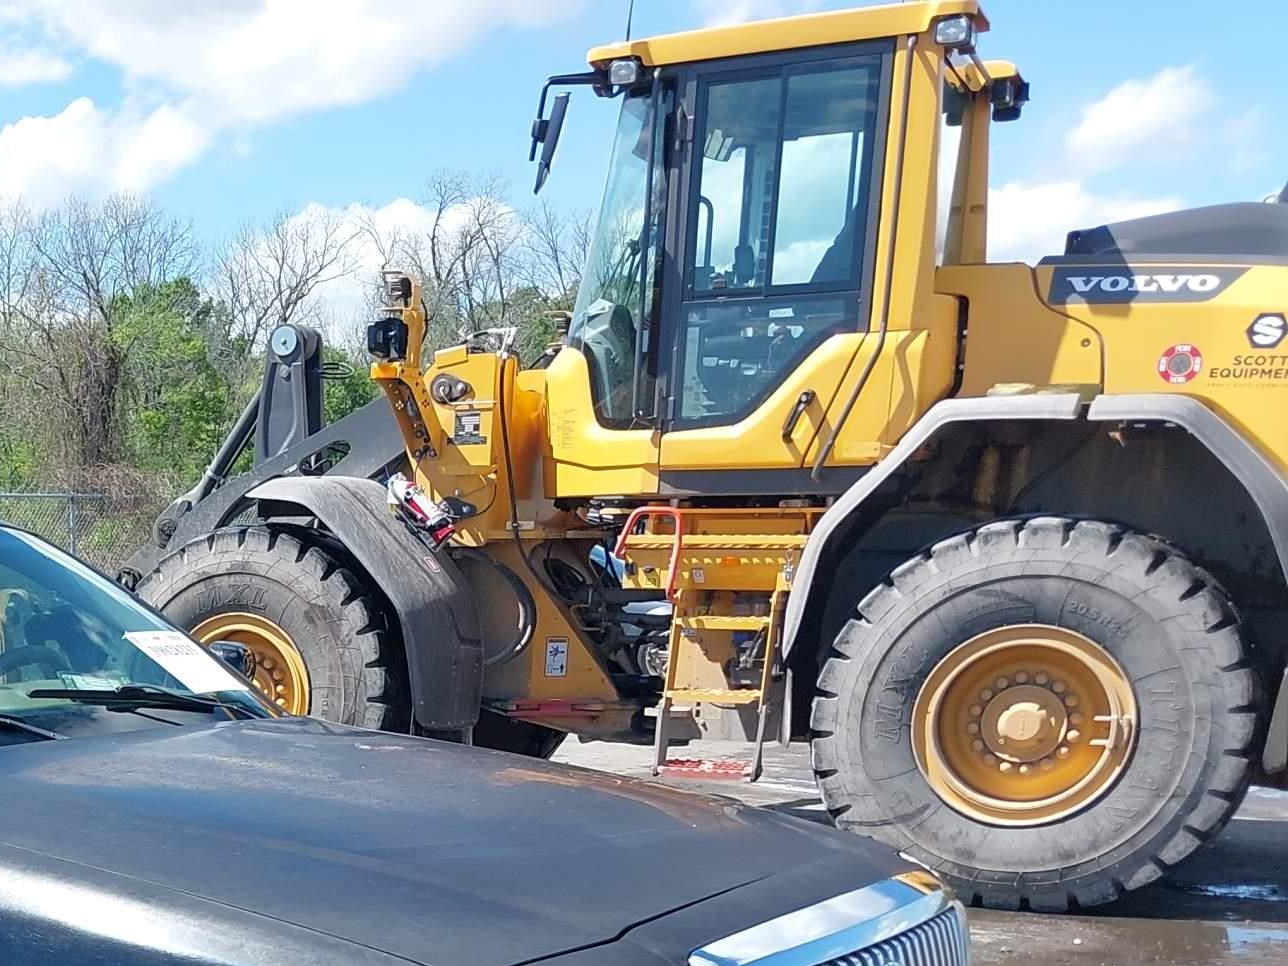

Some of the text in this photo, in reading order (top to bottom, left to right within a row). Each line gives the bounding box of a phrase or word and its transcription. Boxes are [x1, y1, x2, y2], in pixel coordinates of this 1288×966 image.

[1066, 274, 1221, 292] VOLVO
[1252, 315, 1285, 346] S
[1233, 355, 1288, 366] SCOTT
